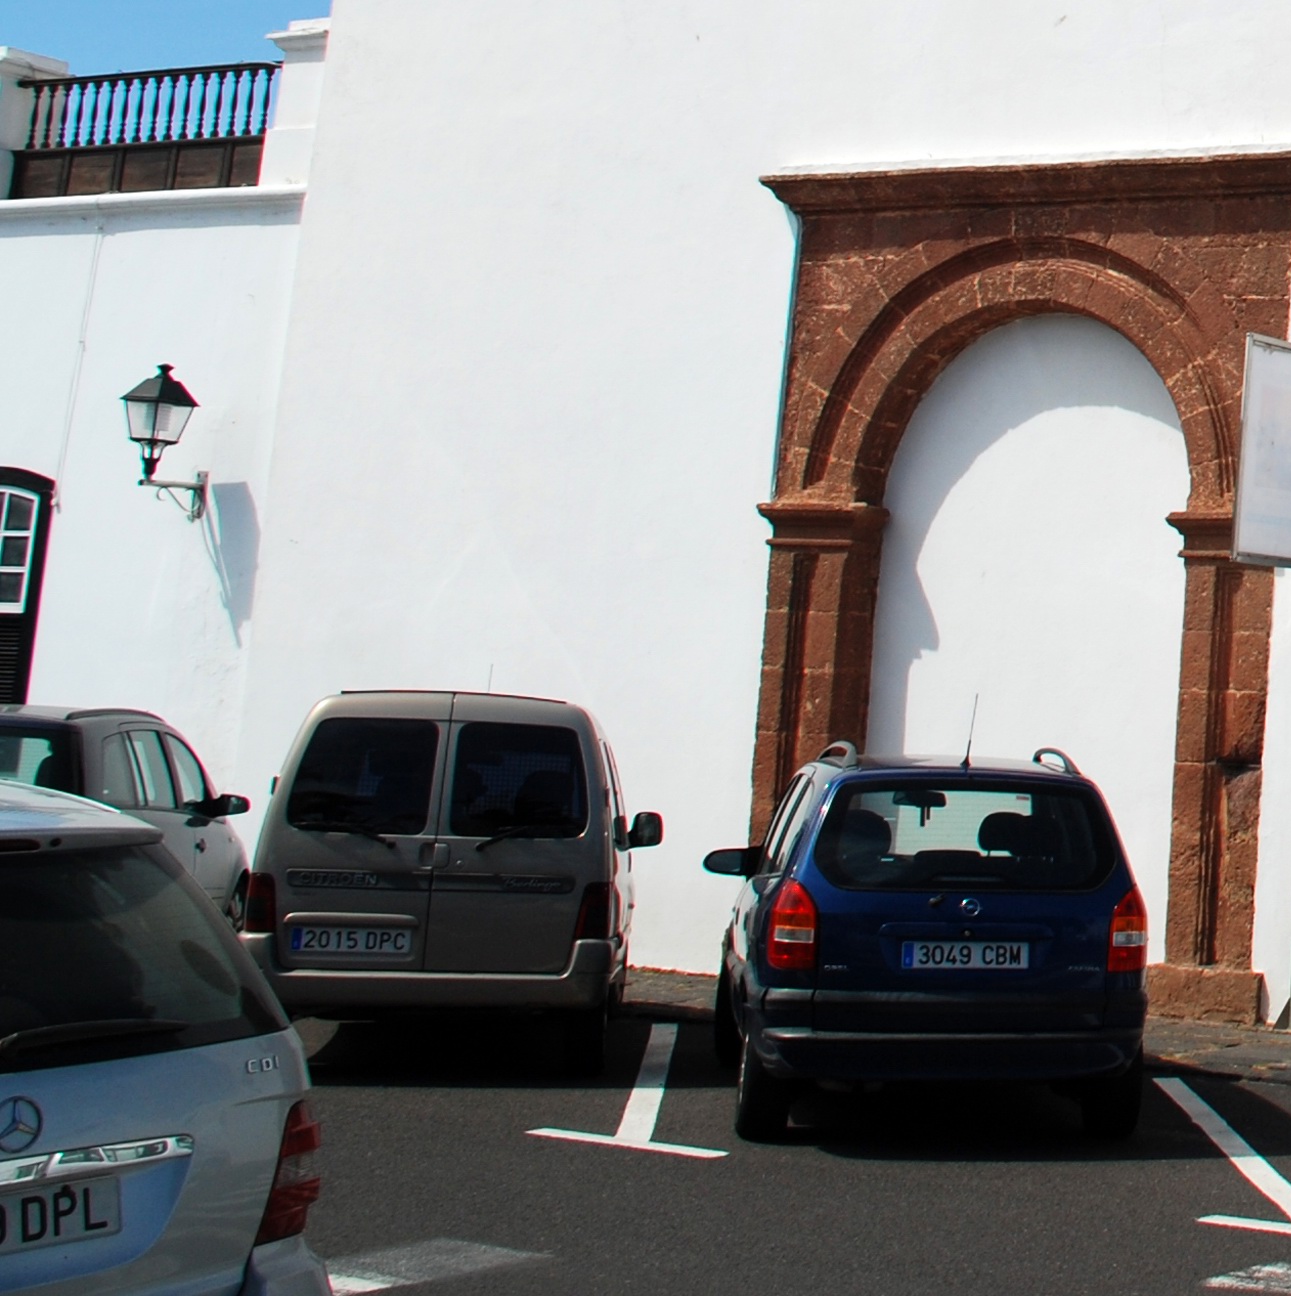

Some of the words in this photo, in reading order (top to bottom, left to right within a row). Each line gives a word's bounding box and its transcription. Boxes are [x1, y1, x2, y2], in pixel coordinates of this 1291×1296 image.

[303, 929, 359, 950] 2015
[365, 931, 406, 951] DPC
[918, 944, 972, 966] 3049
[981, 944, 1022, 966] CBM
[246, 1055, 281, 1074] CDI
[20, 1186, 109, 1244] DPL
